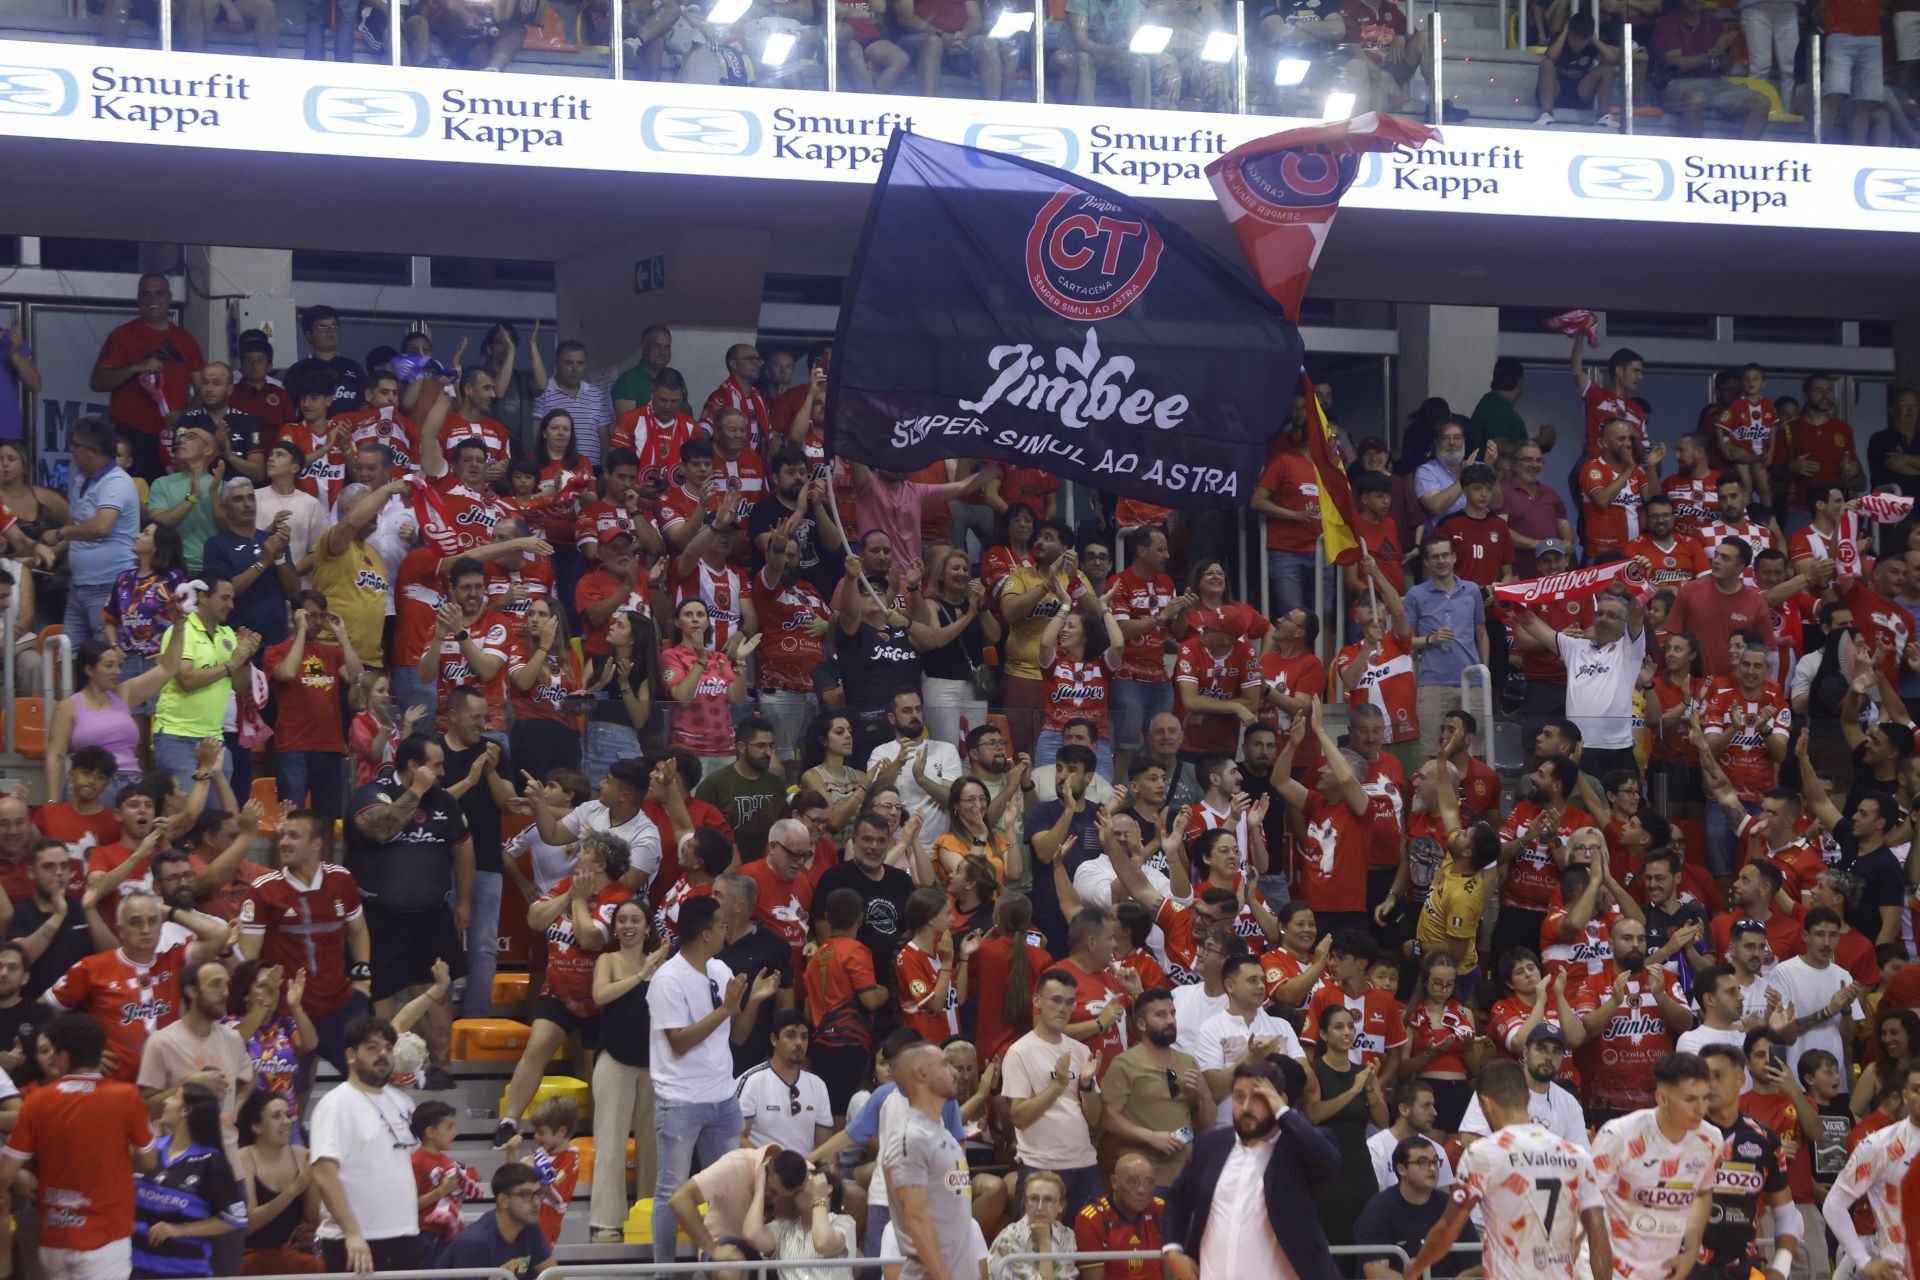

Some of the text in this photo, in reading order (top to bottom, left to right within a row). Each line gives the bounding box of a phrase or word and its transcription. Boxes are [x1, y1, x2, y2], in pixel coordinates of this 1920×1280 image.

[91, 66, 250, 101] Smurfit
[91, 95, 221, 133] Kappa
[442, 89, 592, 121] Smurfit
[441, 117, 564, 152] Kappa
[773, 107, 916, 136] Smurfit
[773, 135, 886, 169] Kappa
[1090, 124, 1227, 154] Smurfit
[1089, 152, 1201, 184] Kappa
[1393, 142, 1524, 170] Smurfit
[1684, 155, 1812, 183] Smurfit
[1393, 168, 1499, 199] Kappa
[1684, 181, 1789, 213] Kappa
[1049, 214, 1142, 275] CT
[1034, 274, 1139, 315] SEMPER SIMUL AD ASTRA
[1057, 276, 1113, 295] CARTAGENA
[959, 335, 1189, 429] Jimbee
[993, 430, 1086, 465] SIMUL
[1093, 450, 1138, 473] AD
[1142, 460, 1238, 497] ASTRA
[1472, 544, 1484, 559] 10
[1535, 1178, 1562, 1241] 7
